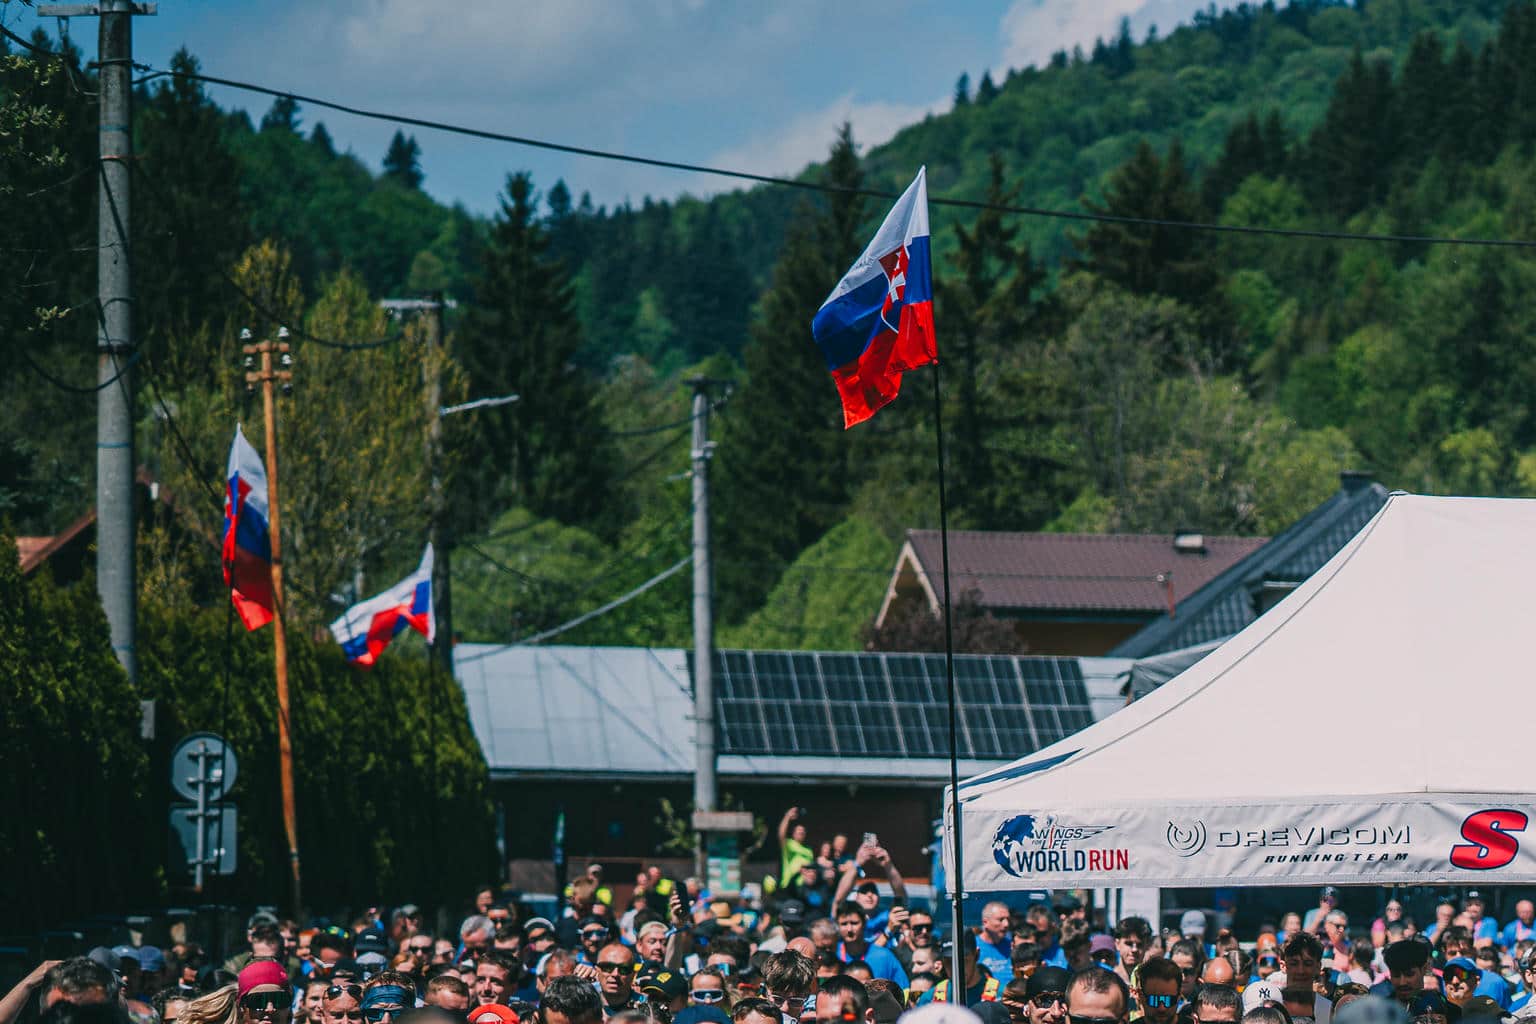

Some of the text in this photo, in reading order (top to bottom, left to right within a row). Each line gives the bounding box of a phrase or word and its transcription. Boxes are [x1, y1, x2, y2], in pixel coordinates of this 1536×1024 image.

[1034, 826, 1083, 839] WINGS
[1215, 825, 1411, 847] DREVICOM
[1041, 839, 1069, 849] LIFE
[1016, 849, 1129, 872] WORLD RUN
[1264, 853, 1409, 863] RUNNING TEAM
